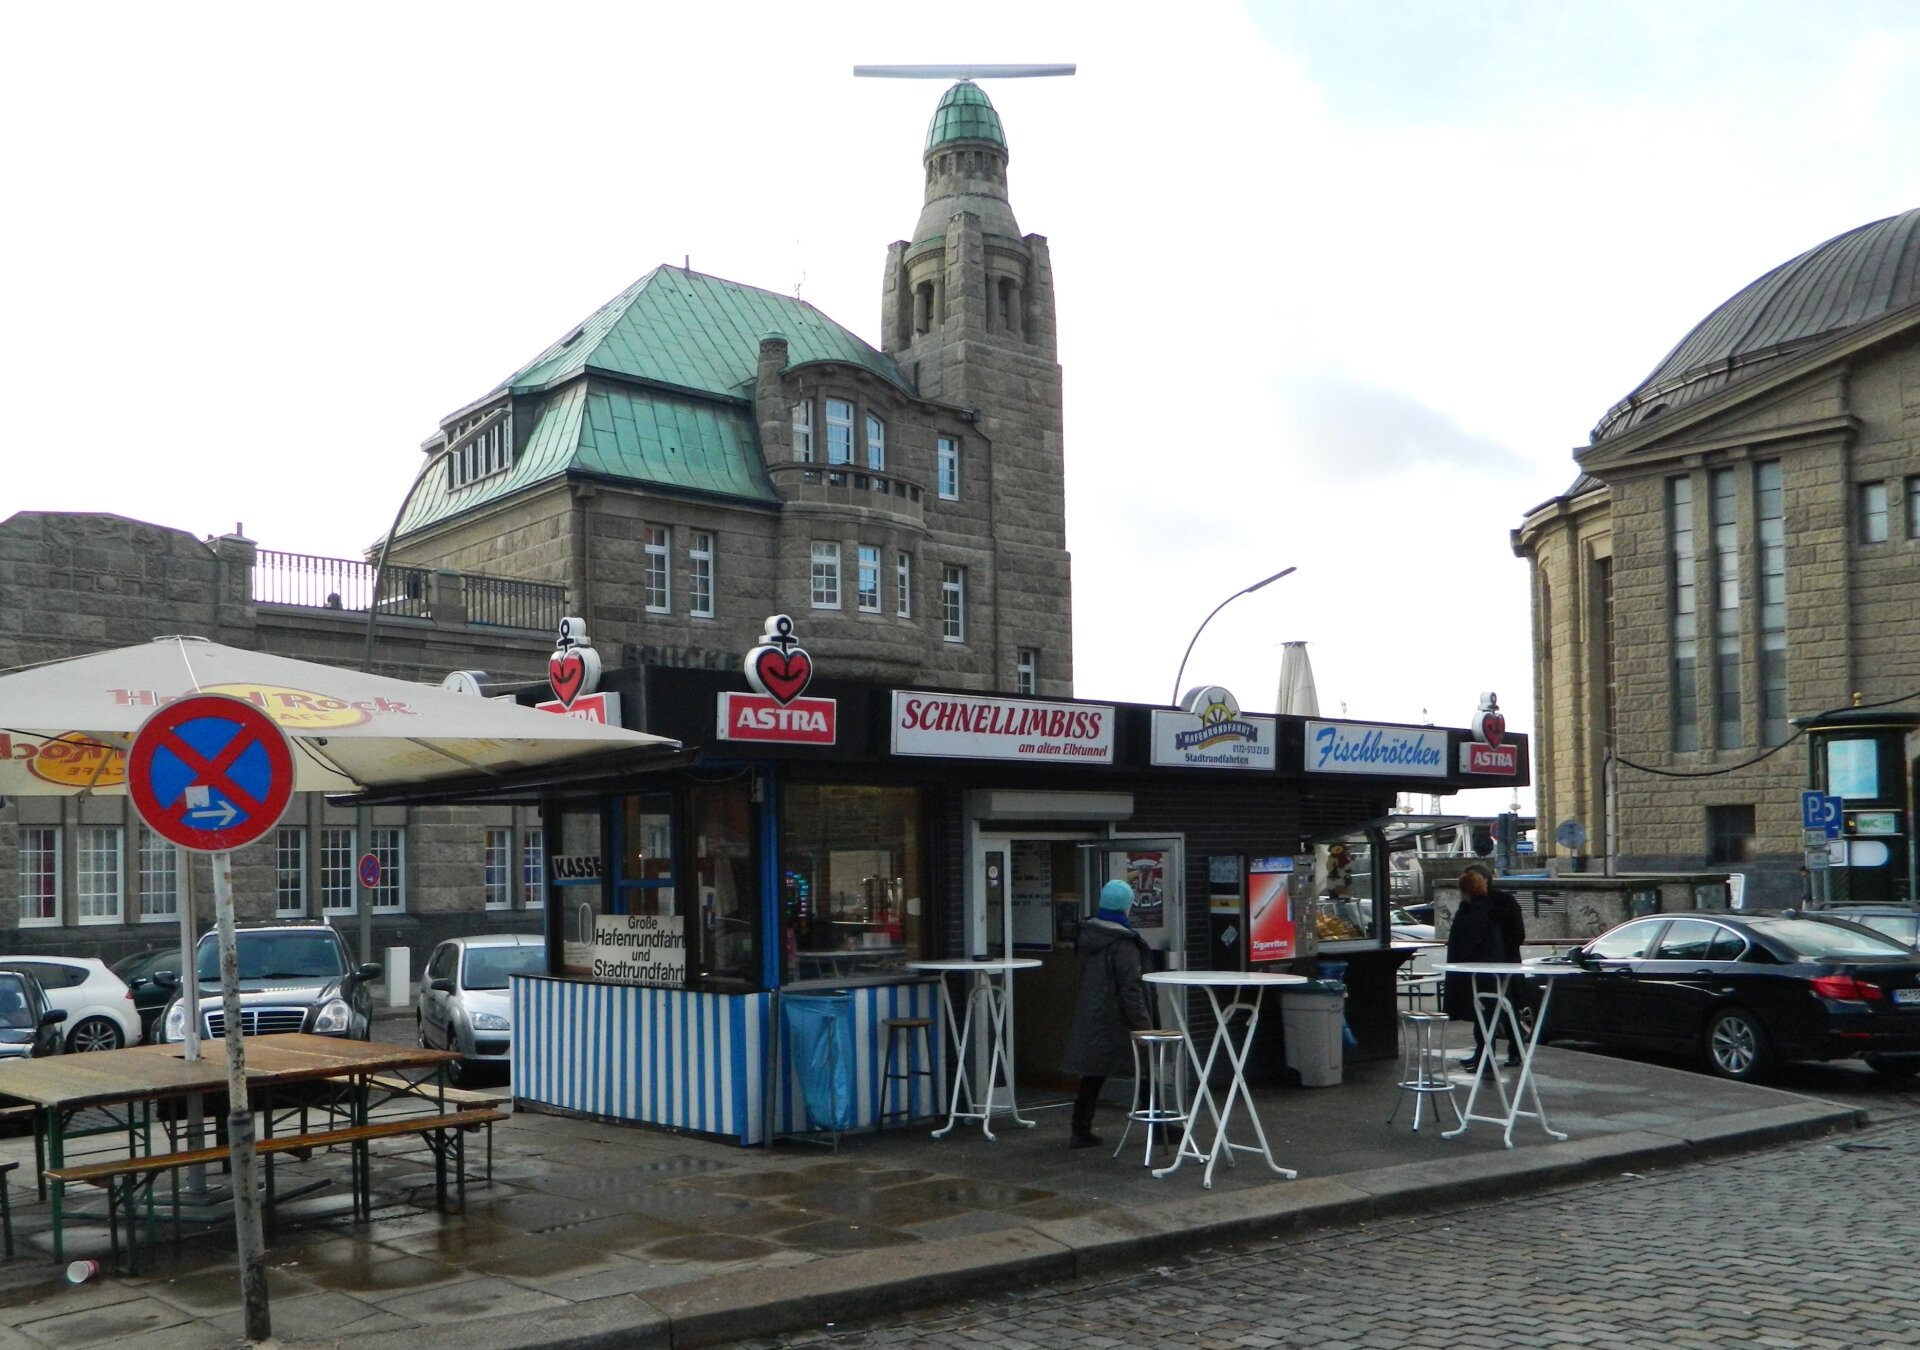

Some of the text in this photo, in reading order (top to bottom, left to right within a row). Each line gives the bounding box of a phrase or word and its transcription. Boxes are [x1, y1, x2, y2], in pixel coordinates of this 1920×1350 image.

[273, 693, 422, 717] Rock
[276, 712, 334, 722] AFE
[736, 706, 828, 732] ASTRA
[901, 699, 1103, 740] SCHNELLIMBISS
[1184, 723, 1251, 744] HAFENRUNDFAHRT
[1018, 742, 1108, 757] am alten Elbtunnel
[1185, 752, 1249, 764] Stadtrundfahrten
[1316, 727, 1442, 768] Fischbrötchen
[1474, 751, 1513, 767] ASTRA
[1807, 796, 1820, 823] P
[554, 856, 602, 878] KASSE
[627, 915, 658, 930] Große
[595, 928, 686, 949] Hafenrundfahrt
[1253, 940, 1288, 951] Zigaretten
[632, 949, 651, 962] und
[593, 958, 685, 982] Stadtrundfahrt
